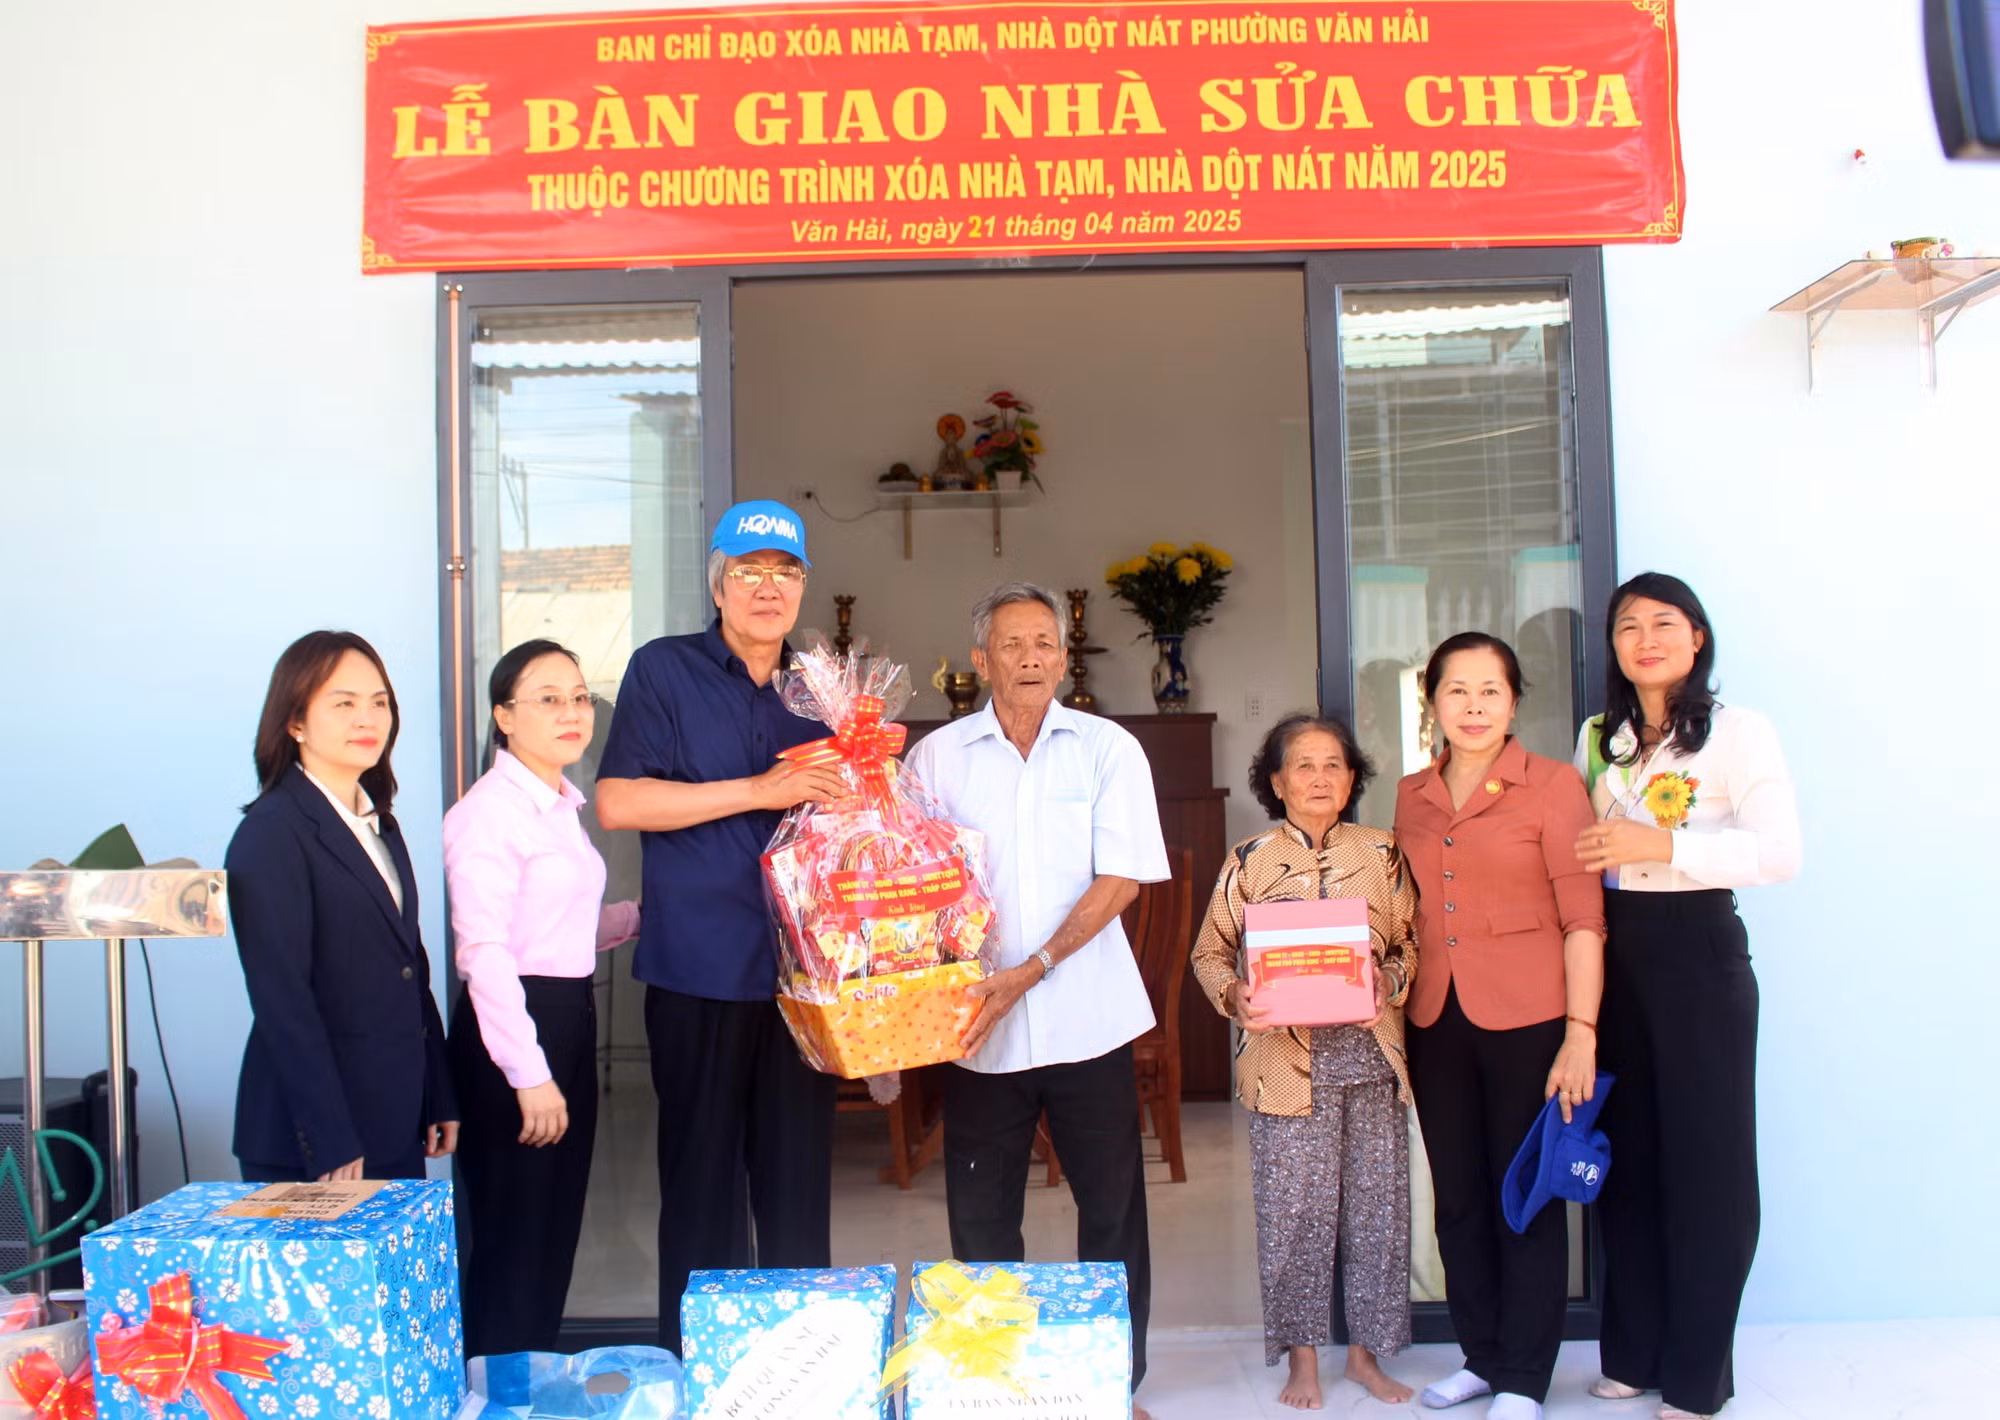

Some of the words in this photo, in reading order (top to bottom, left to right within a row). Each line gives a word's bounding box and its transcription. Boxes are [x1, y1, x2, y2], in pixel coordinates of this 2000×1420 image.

[597, 35, 655, 62] BAN
[664, 25, 712, 61] CHỈ
[719, 31, 777, 64] ĐẠO
[785, 24, 843, 57] XÓA
[851, 22, 911, 55] NHÀ
[917, 24, 988, 58] TẠM,
[997, 16, 1056, 49] NHÀ
[1064, 16, 1118, 53] DỘT
[1127, 15, 1182, 47] NÁT
[1191, 12, 1308, 46] PHƯỜNG
[1315, 12, 1373, 43] VĂN
[1381, 8, 1429, 43] HẢI
[391, 84, 492, 159] LỄ
[523, 86, 700, 154] BÀN
[734, 88, 947, 146] GIAO
[980, 71, 1167, 139] NHÀ
[1199, 62, 1374, 133] SỬA
[1405, 66, 1643, 128] CHỮA
[528, 166, 629, 217] THUỘC
[639, 166, 770, 208] CHƯƠNG
[779, 160, 875, 204] TRÌNH
[884, 157, 950, 201] XÓA
[959, 155, 1027, 199] NHÀ
[1035, 159, 1115, 203] TẠM,
[1125, 149, 1193, 194] NHÀ
[1201, 148, 1263, 199] DỘT
[1272, 146, 1335, 191] NÁT
[1345, 144, 1419, 190] NĂM
[1429, 149, 1507, 189] 2025
[791, 220, 838, 243] Văn
[845, 217, 892, 244] Hải,
[901, 221, 964, 245] ngày
[968, 215, 996, 238] 21
[1005, 213, 1077, 241] tháng
[1084, 212, 1113, 235] 04
[1121, 212, 1175, 234] năm
[1183, 209, 1241, 232] 2025
